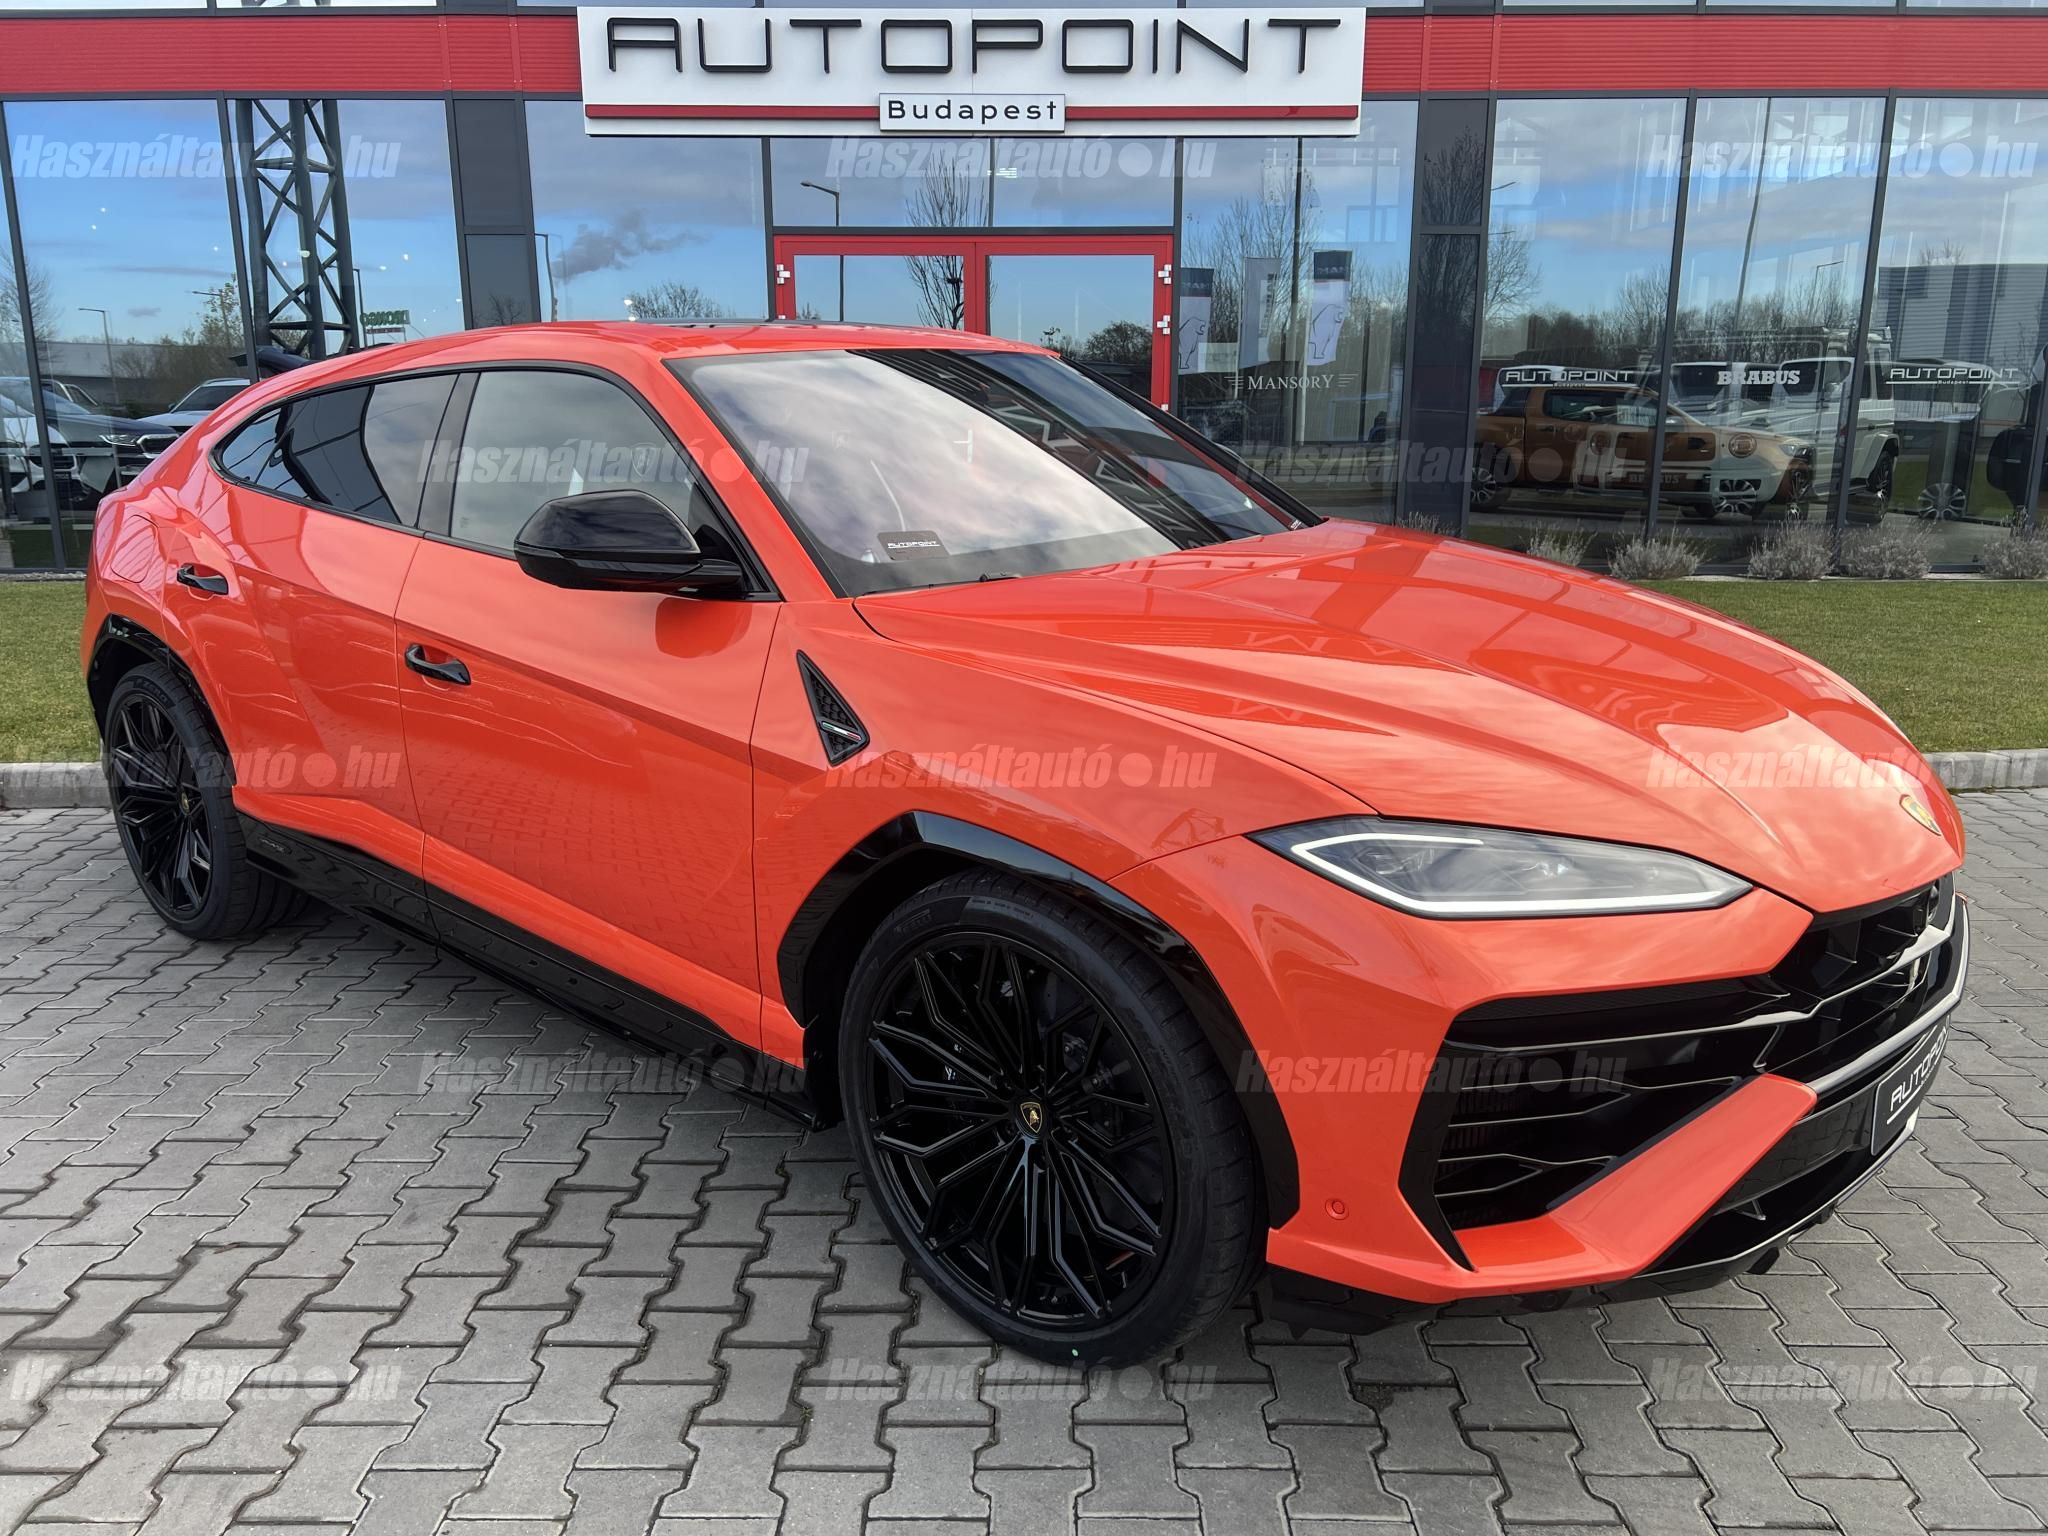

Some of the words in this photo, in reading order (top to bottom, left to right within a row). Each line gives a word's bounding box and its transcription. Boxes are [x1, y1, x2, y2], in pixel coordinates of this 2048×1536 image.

[607, 17, 1342, 75] AUTOPOINT
[887, 100, 1059, 126] Budapest
[1505, 370, 1634, 382] AUTOPOINT
[1717, 370, 1801, 385] BRABUS
[1889, 367, 2019, 379] AUTOPOINT
[1247, 374, 1335, 390] MANSORY
